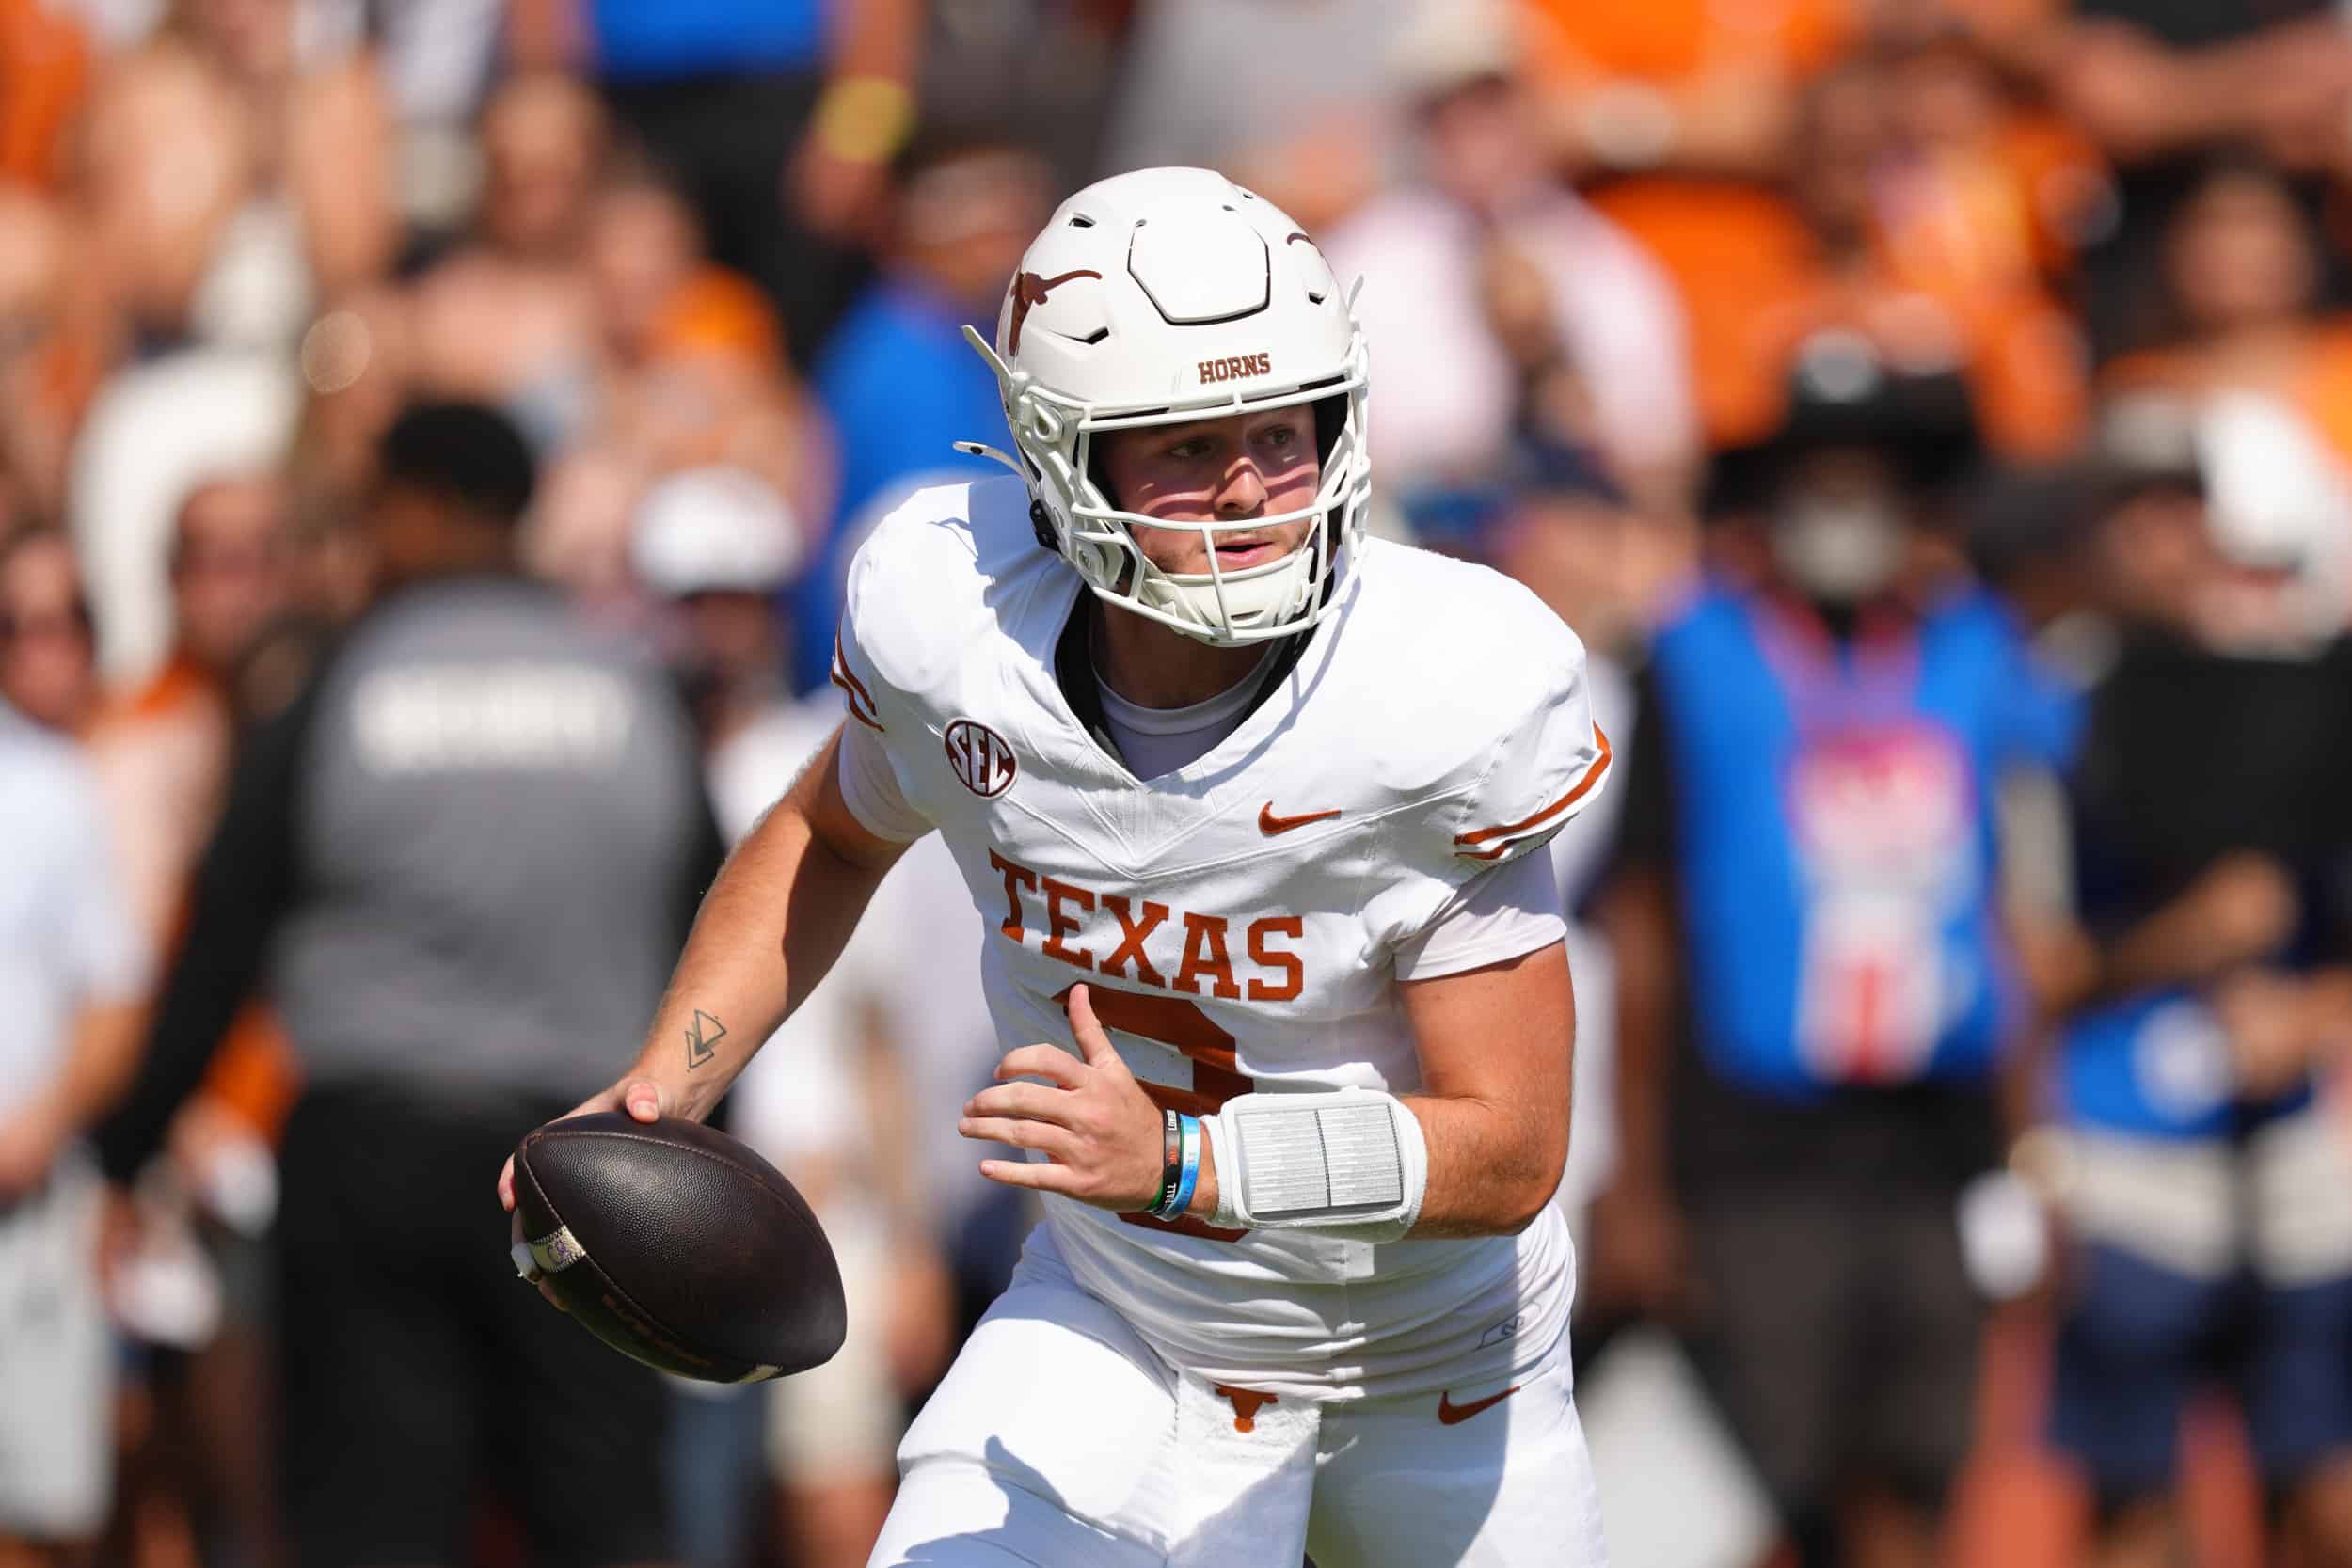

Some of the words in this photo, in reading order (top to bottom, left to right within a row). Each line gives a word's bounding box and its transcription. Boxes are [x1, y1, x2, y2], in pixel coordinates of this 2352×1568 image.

[1198, 352, 1271, 384] HORNS
[946, 722, 1010, 795] SEC
[989, 847, 1304, 1001] TEXAS
